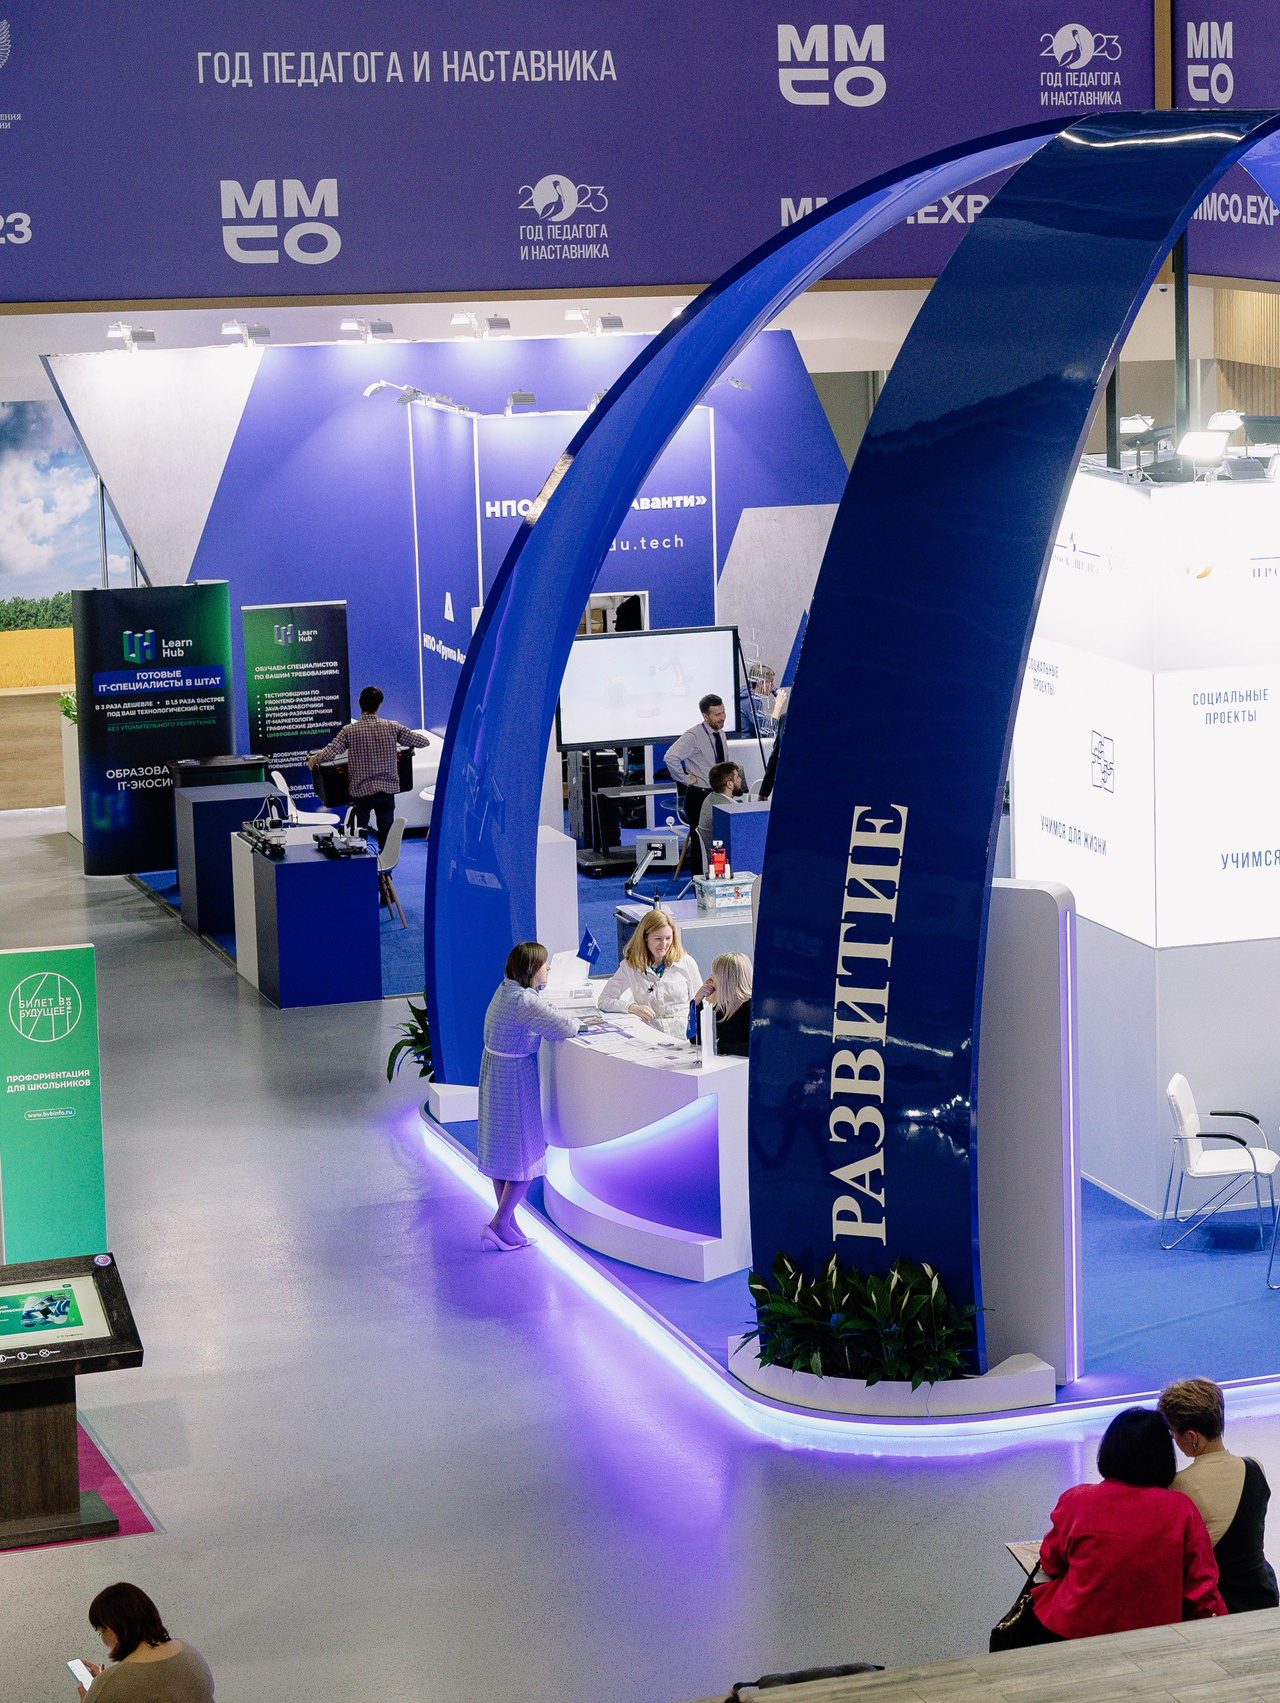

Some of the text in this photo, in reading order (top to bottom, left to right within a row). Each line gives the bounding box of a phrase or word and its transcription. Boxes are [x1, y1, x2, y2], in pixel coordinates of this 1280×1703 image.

[197, 50, 617, 87] ГОД ПЕДАГОГА И НАСТАВНИКА
[1040, 72, 1121, 87] ГОД ПЕДАГОГА
[1040, 91, 1122, 106] И НАСТАВНИКА
[0, 113, 22, 121] ЕНИЯ
[520, 224, 608, 241] ГОД ПЕДАГОГА
[520, 244, 609, 260] И НАСТАВНИКА
[485, 499, 534, 518] НПО
[161, 639, 193, 648] Learn
[162, 648, 184, 658] Hub
[287, 661, 338, 670] СПЕЦИАЛИСТОВ
[136, 670, 182, 680] ГОТОВЫЕ
[194, 677, 221, 686] ШТАТ
[1192, 689, 1269, 706] СОЦИАЛЬНЫЕ
[137, 706, 198, 715] ТЕХНОЛОГИЧЕСКИЙ
[1205, 710, 1257, 725] ПРОЕКТЫ
[268, 756, 307, 764] СПЕЦИАЛИСТО
[106, 765, 170, 779] ОБРАЗОВА
[117, 778, 173, 791] IT-ЭКОСИ
[1040, 814, 1107, 856] УЧИМСЯ ДЛЯ ЖИЗНИ
[19, 997, 65, 1009] БИЛЕТ В
[19, 1006, 65, 1018] БУДУЩЕЕ
[829, 804, 908, 1246] РАЗВИТИЕ
[6, 1069, 90, 1083] ПРОФОРИЕНТАЦИЯ
[6, 1079, 91, 1093] ДЛЯ ШКОЛЬНИКОВ
